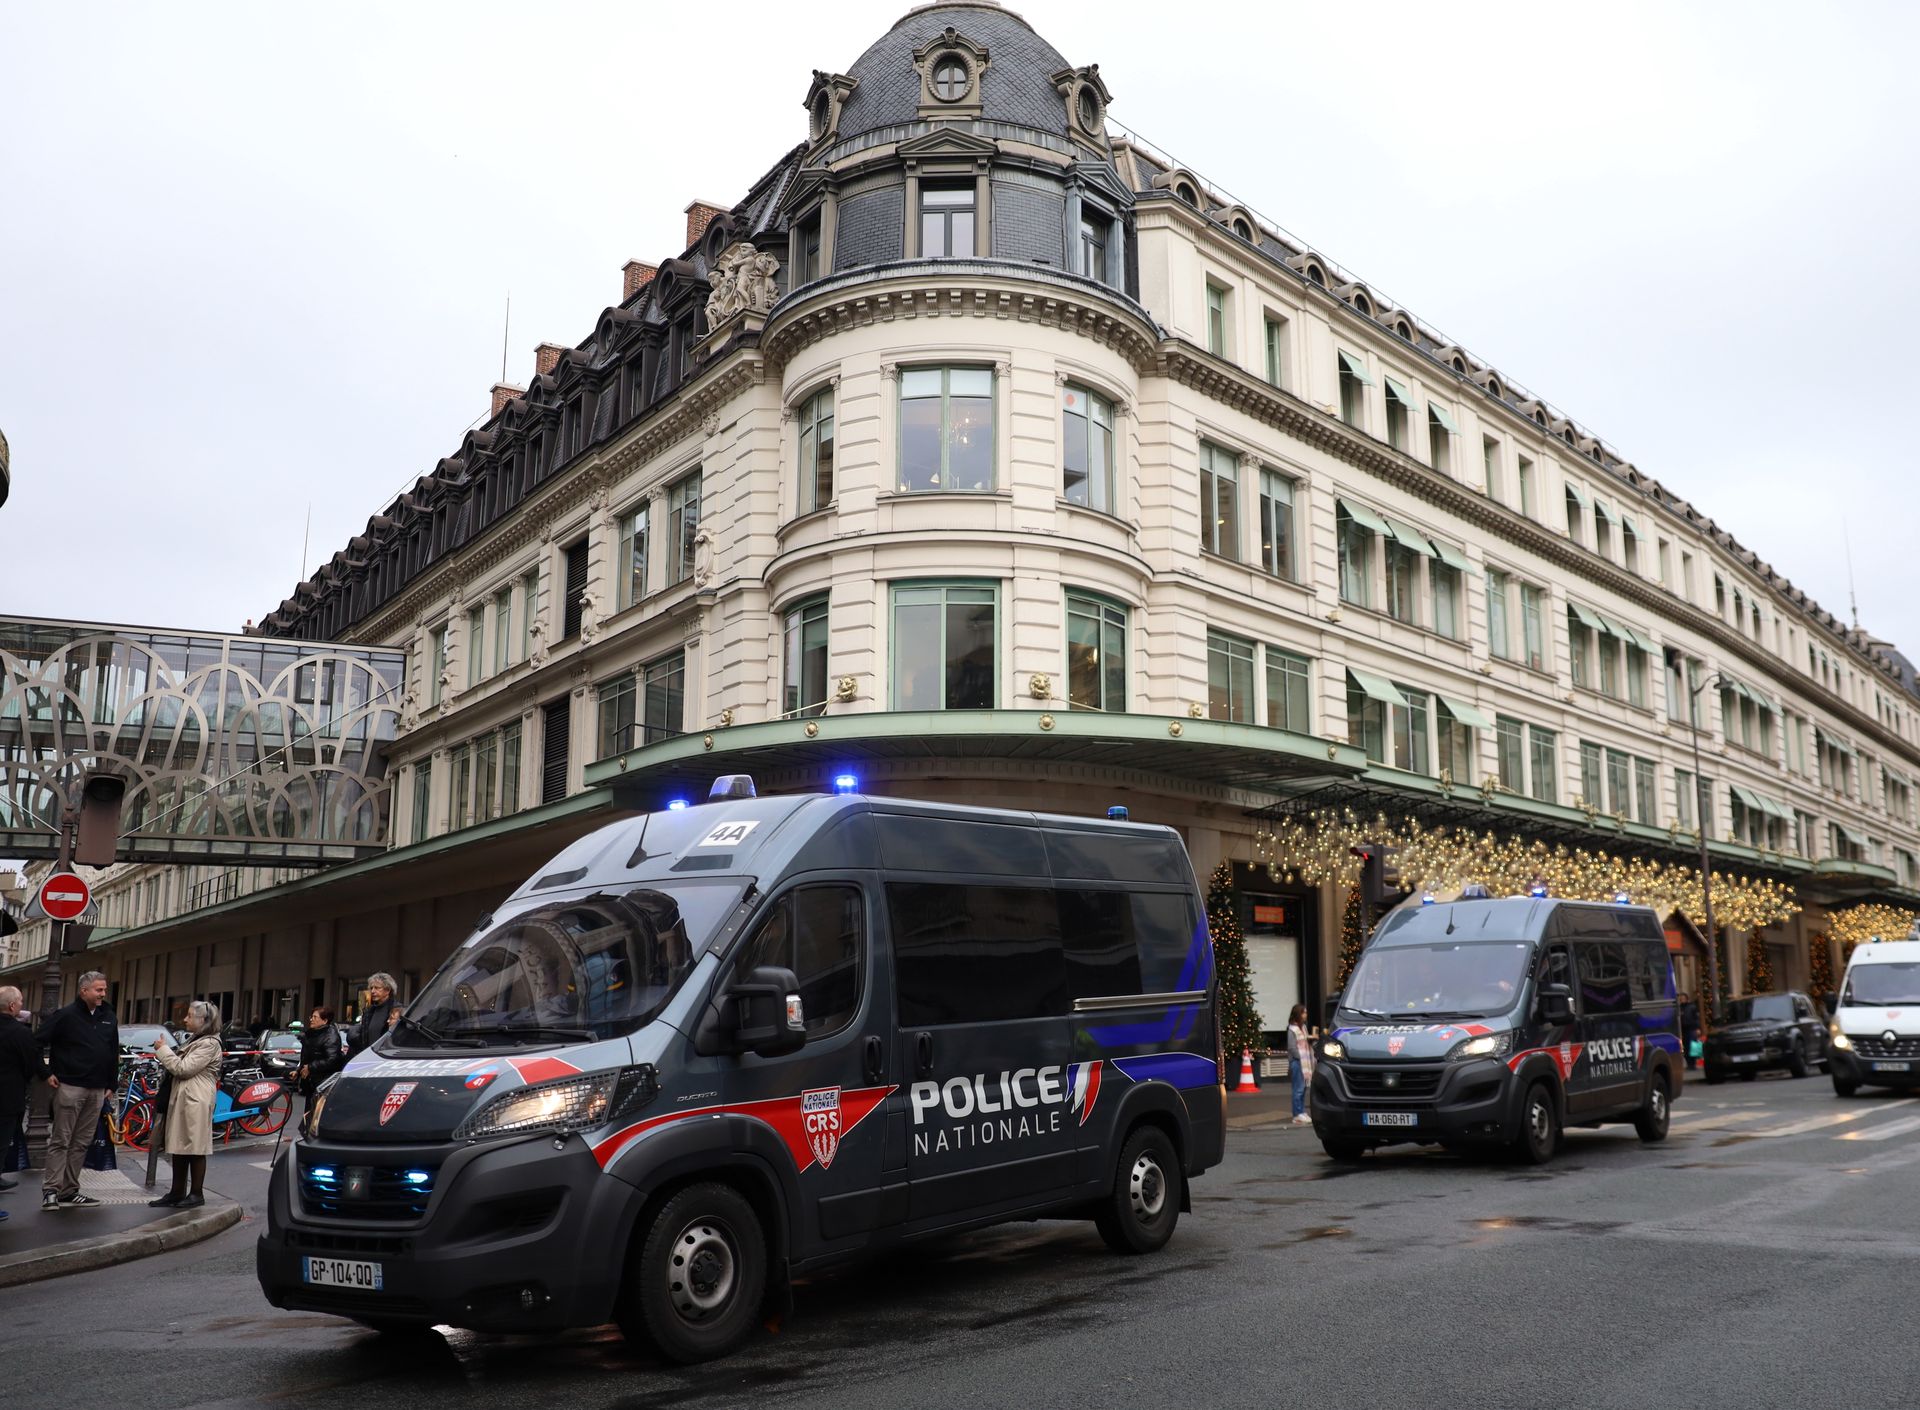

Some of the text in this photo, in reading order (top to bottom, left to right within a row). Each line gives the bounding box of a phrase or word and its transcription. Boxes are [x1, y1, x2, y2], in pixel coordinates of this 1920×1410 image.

[709, 825, 747, 841] 4A
[1588, 1037, 1632, 1062] POLICE
[374, 1060, 465, 1070] POLICE
[1590, 1061, 1633, 1078] NATIONALE
[385, 1095, 406, 1104] CRS
[808, 1092, 834, 1102] POLICE
[911, 1065, 1063, 1124] POLICE
[804, 1100, 836, 1111] NATIONALE
[807, 1111, 839, 1133] CRS
[914, 1111, 1060, 1156] NATIONALE
